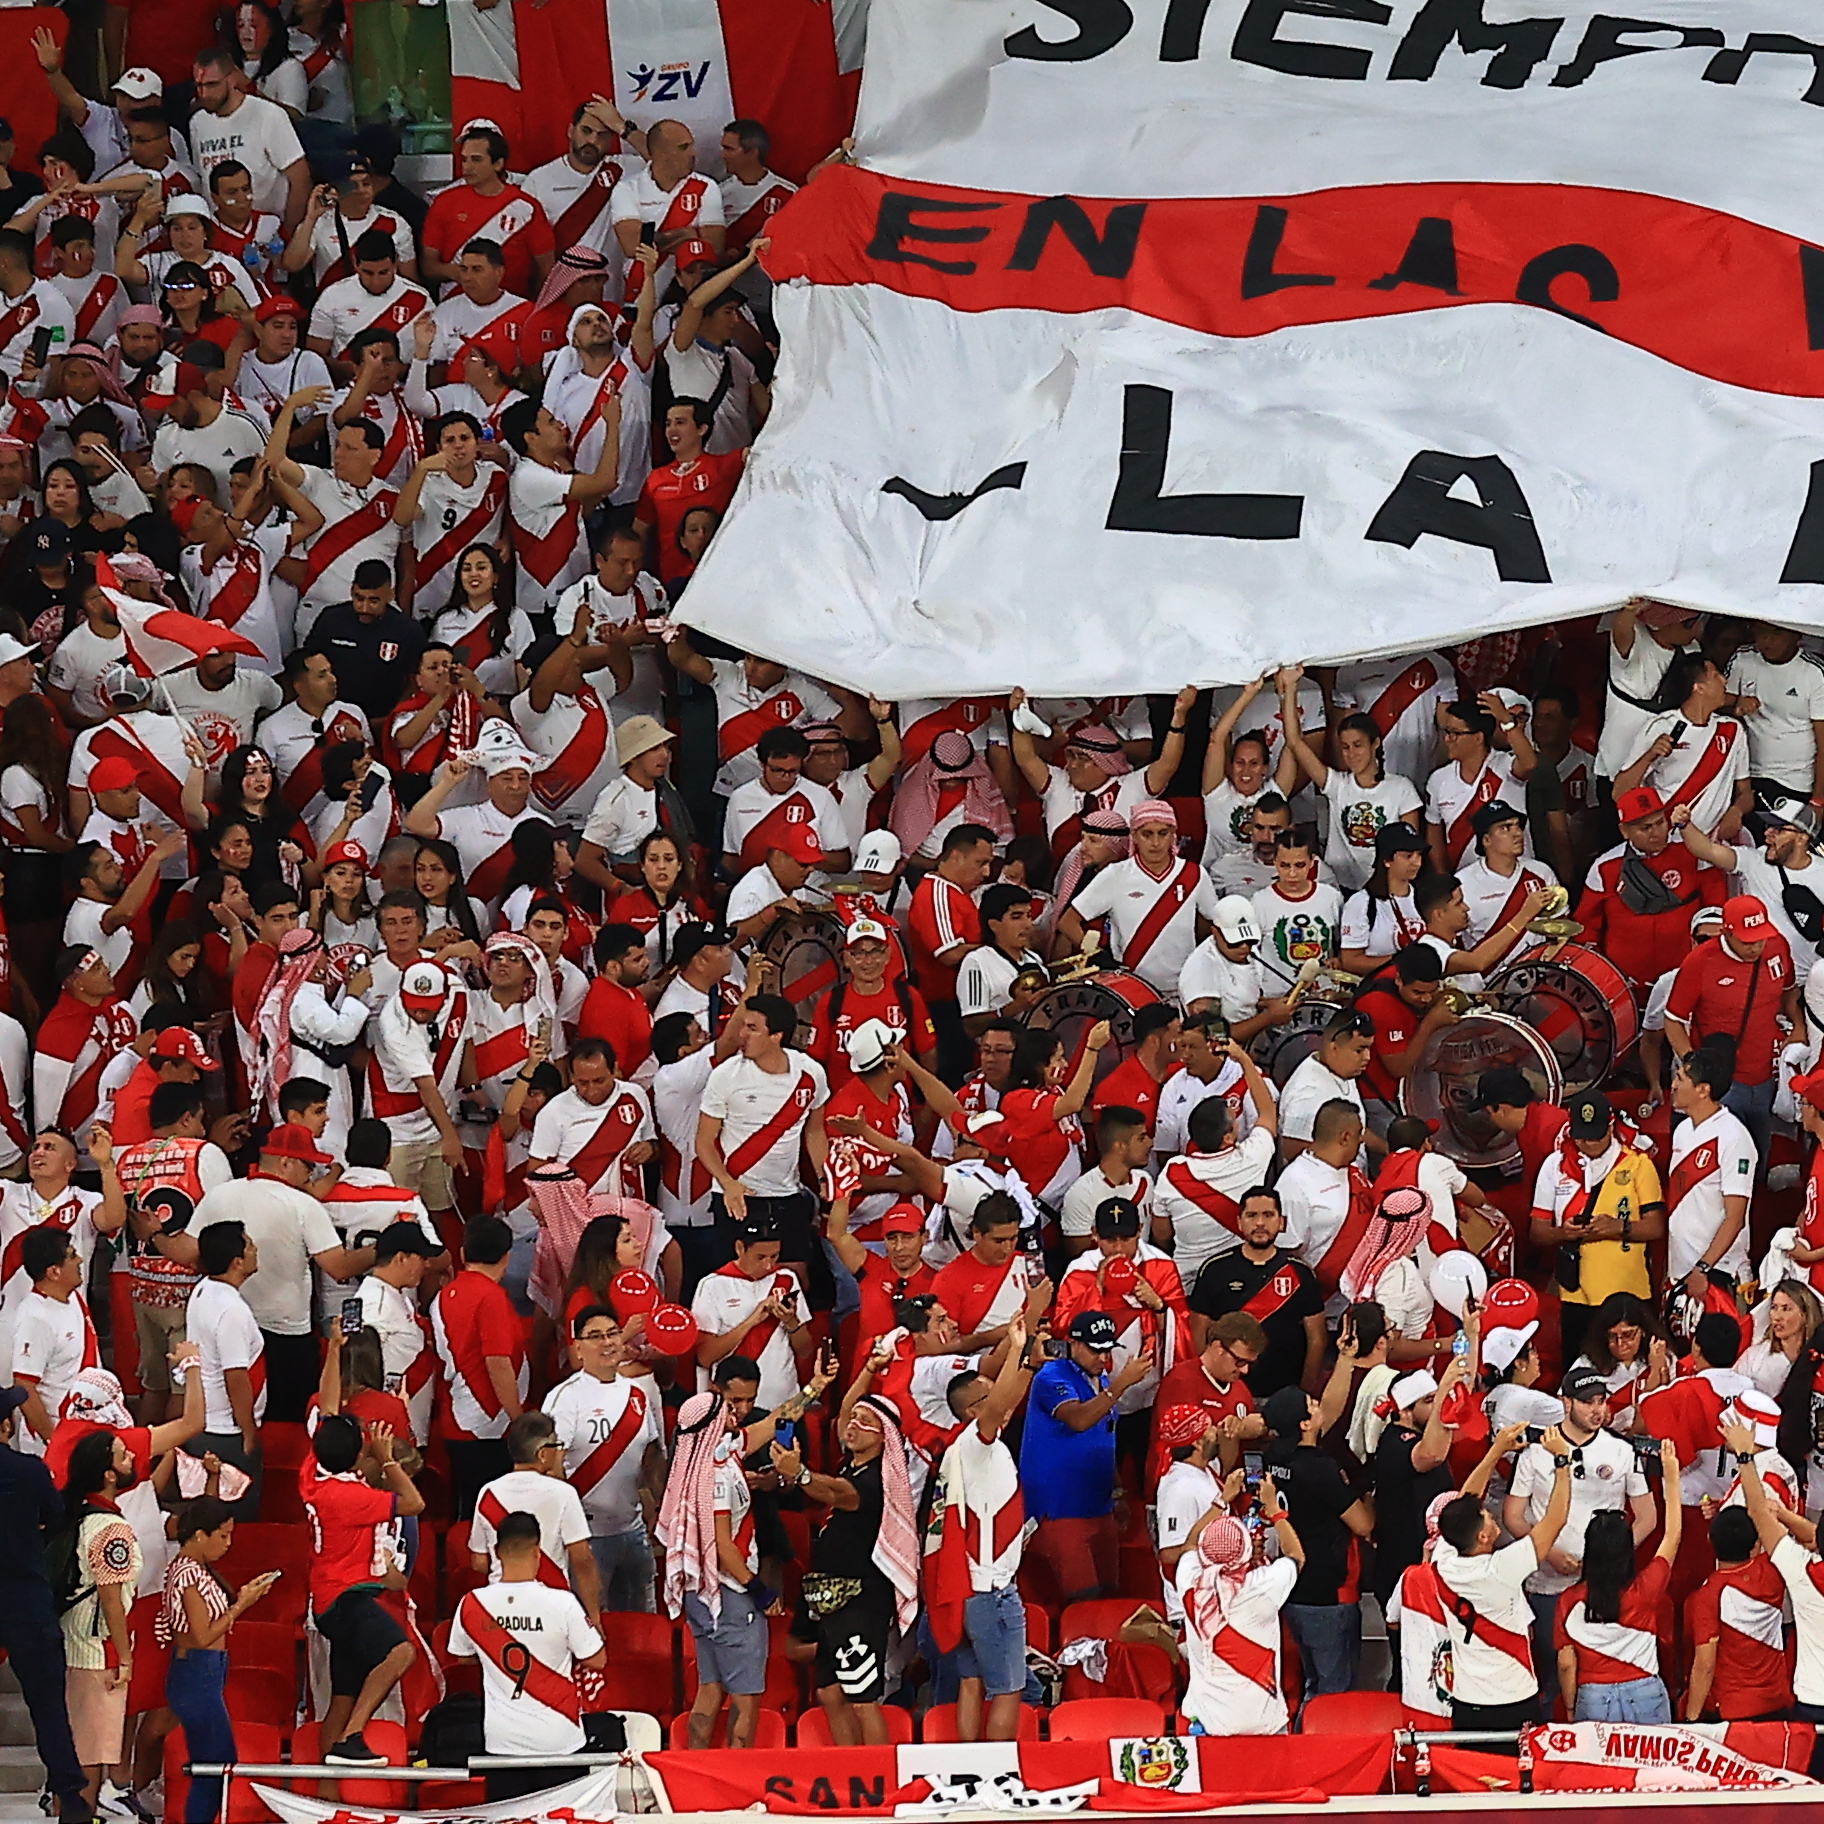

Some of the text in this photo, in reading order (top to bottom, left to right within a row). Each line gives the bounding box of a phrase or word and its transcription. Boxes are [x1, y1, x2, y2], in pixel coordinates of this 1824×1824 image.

[230, 134, 245, 149] EL
[866, 190, 1148, 280] EN
[1105, 382, 1552, 585] LA
[441, 507, 458, 531] 9
[588, 1418, 612, 1444] 20
[500, 1640, 531, 1701] 9
[764, 1775, 887, 1808] SAN
